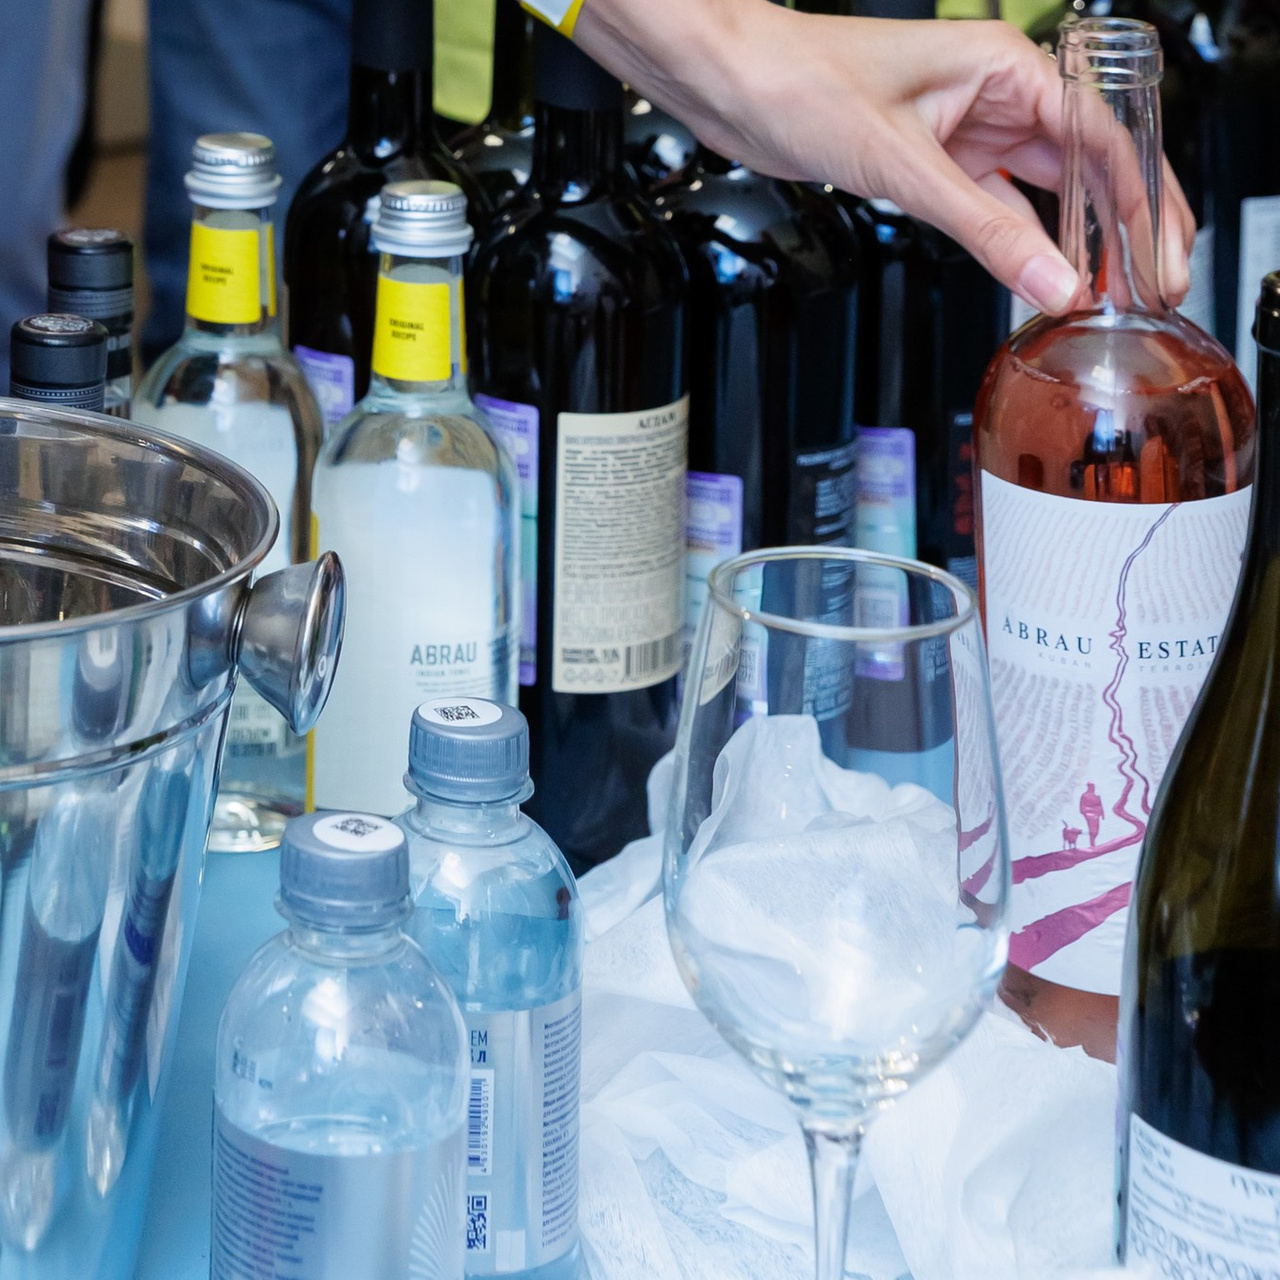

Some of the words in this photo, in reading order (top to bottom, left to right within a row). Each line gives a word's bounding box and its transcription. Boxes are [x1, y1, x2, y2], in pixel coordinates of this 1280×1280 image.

[410, 641, 477, 665] ABRAU
[1002, 616, 1092, 655] ABRAU
[1138, 635, 1218, 659] ESTAT
